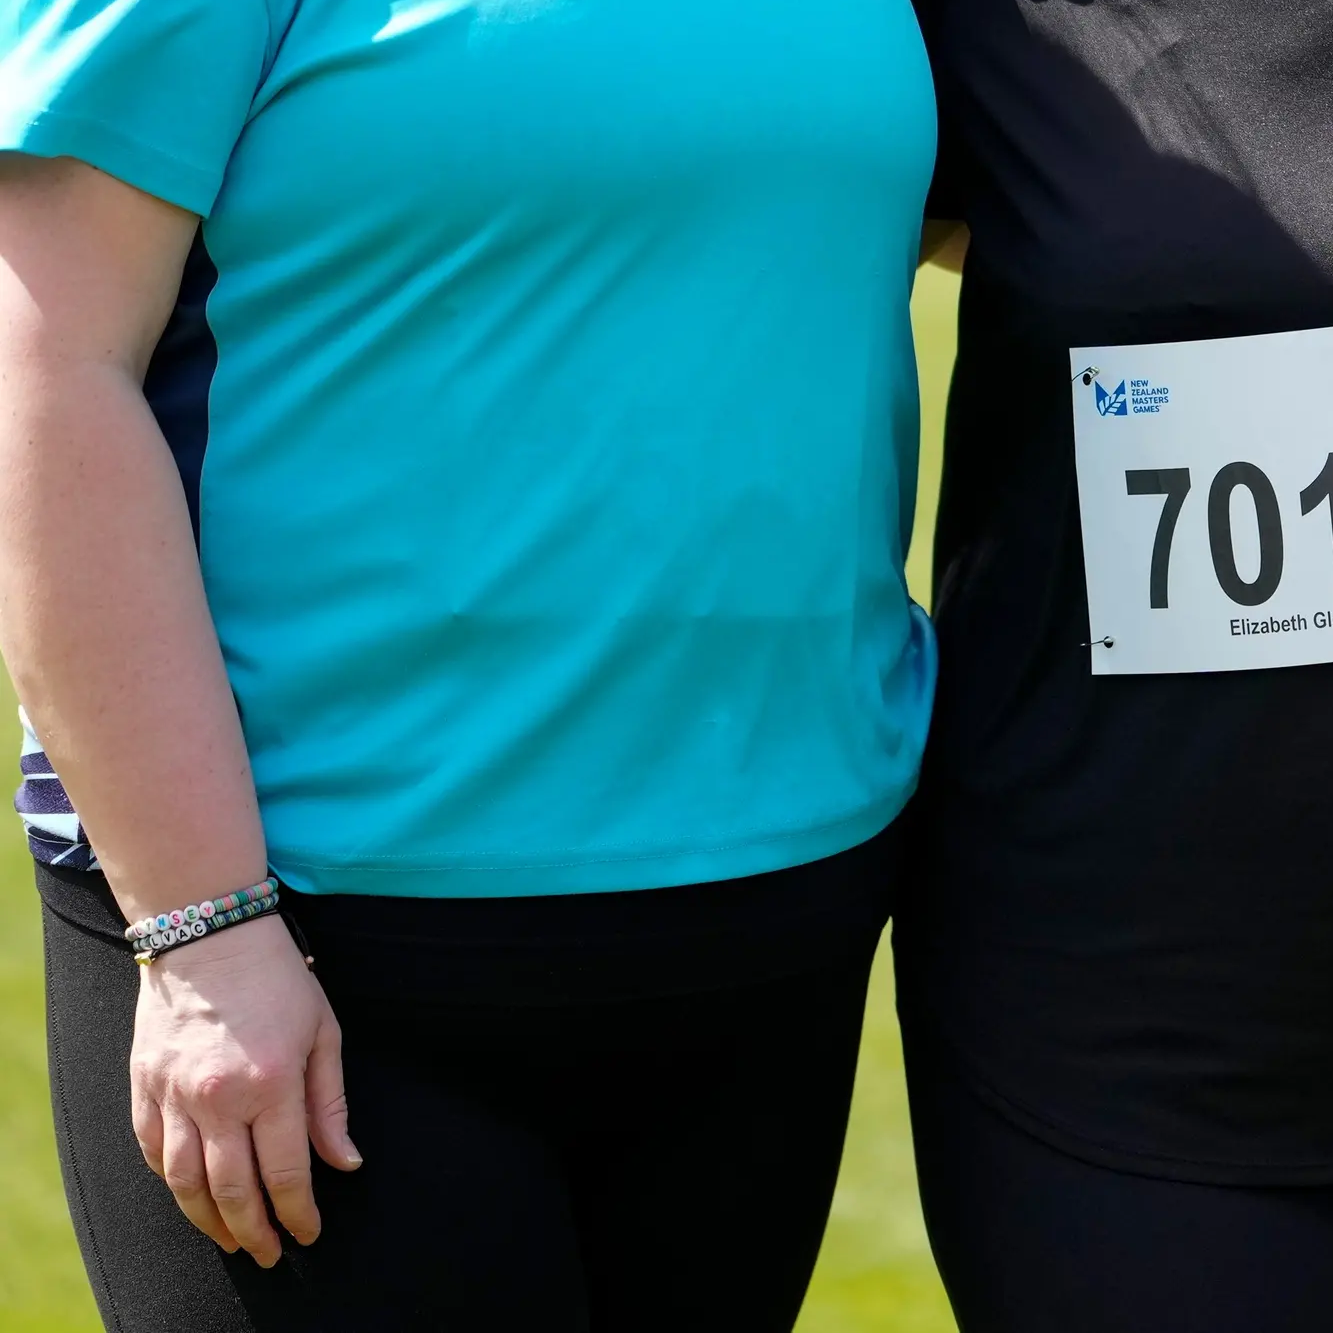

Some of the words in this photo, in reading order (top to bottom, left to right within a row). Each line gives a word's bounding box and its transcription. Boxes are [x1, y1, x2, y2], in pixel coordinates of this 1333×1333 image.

[1130, 380, 1149, 388] NEW
[1131, 388, 1169, 396] ZEALAND
[1132, 396, 1169, 405] MASTERS
[1133, 405, 1160, 413] GAMES
[1230, 613, 1308, 636] Elizabeth
[151, 922, 204, 947] LVAC
